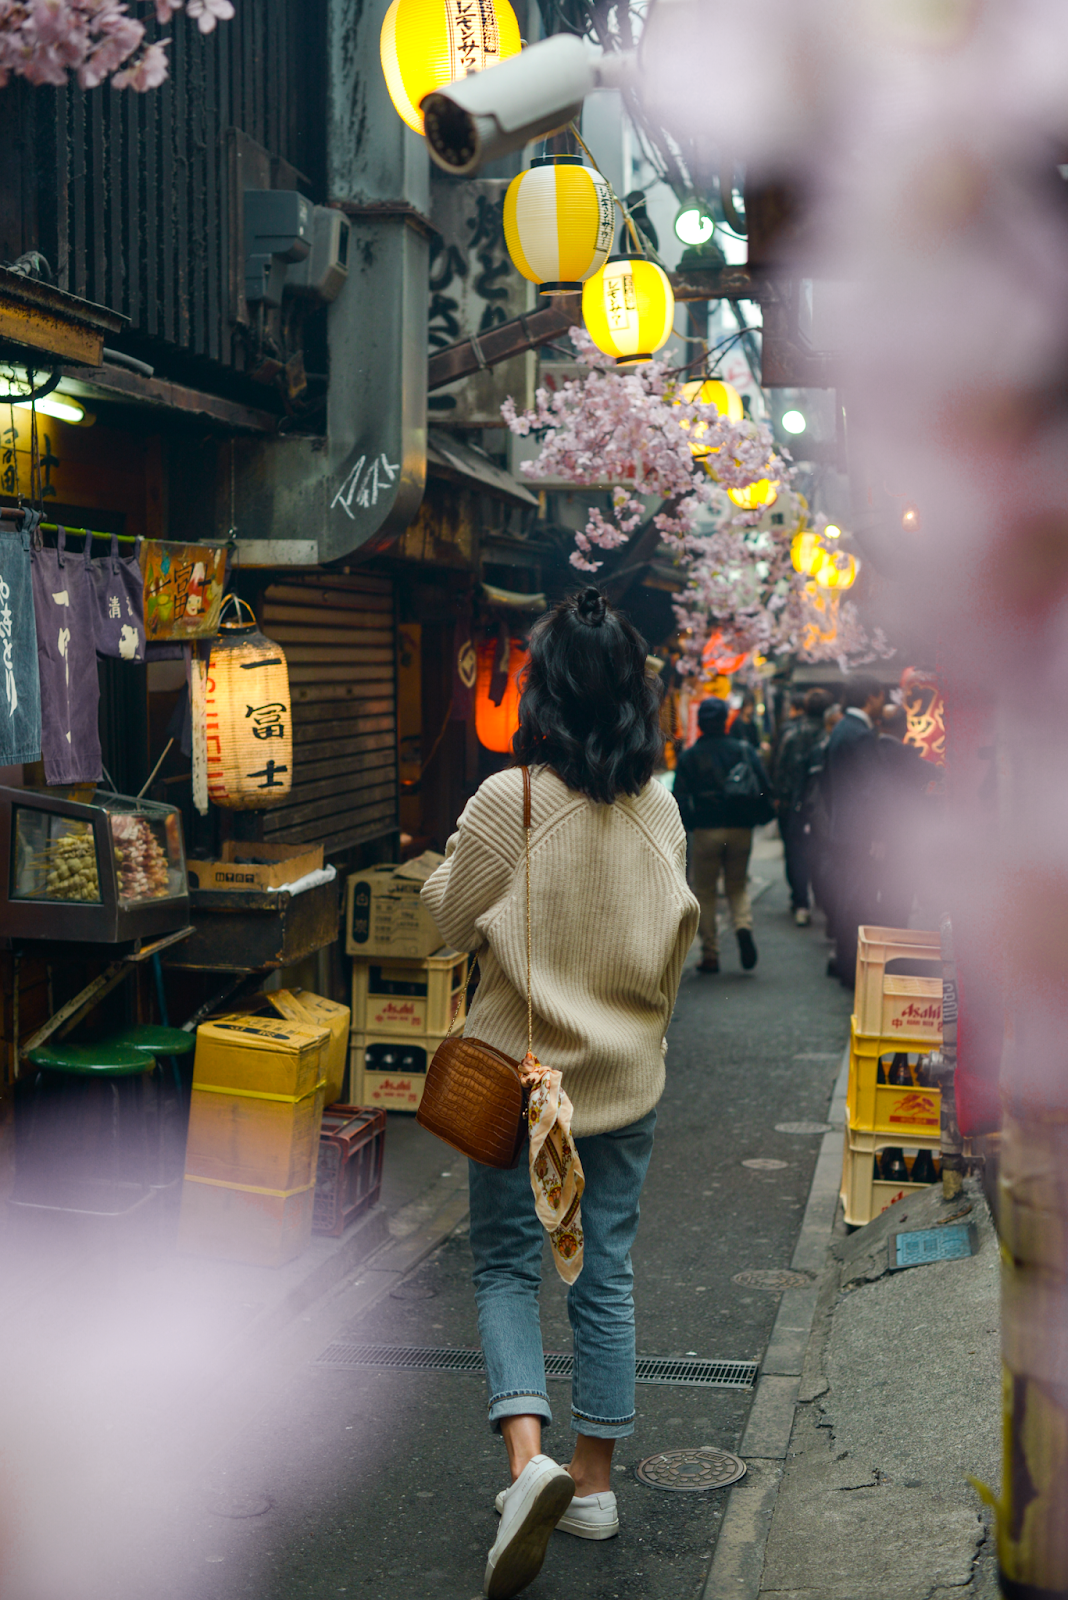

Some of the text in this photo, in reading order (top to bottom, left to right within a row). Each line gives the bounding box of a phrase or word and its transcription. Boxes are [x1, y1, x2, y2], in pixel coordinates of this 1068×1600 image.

[455, 0, 479, 77] レモンサワ
[901, 1003, 942, 1019] Asahi
